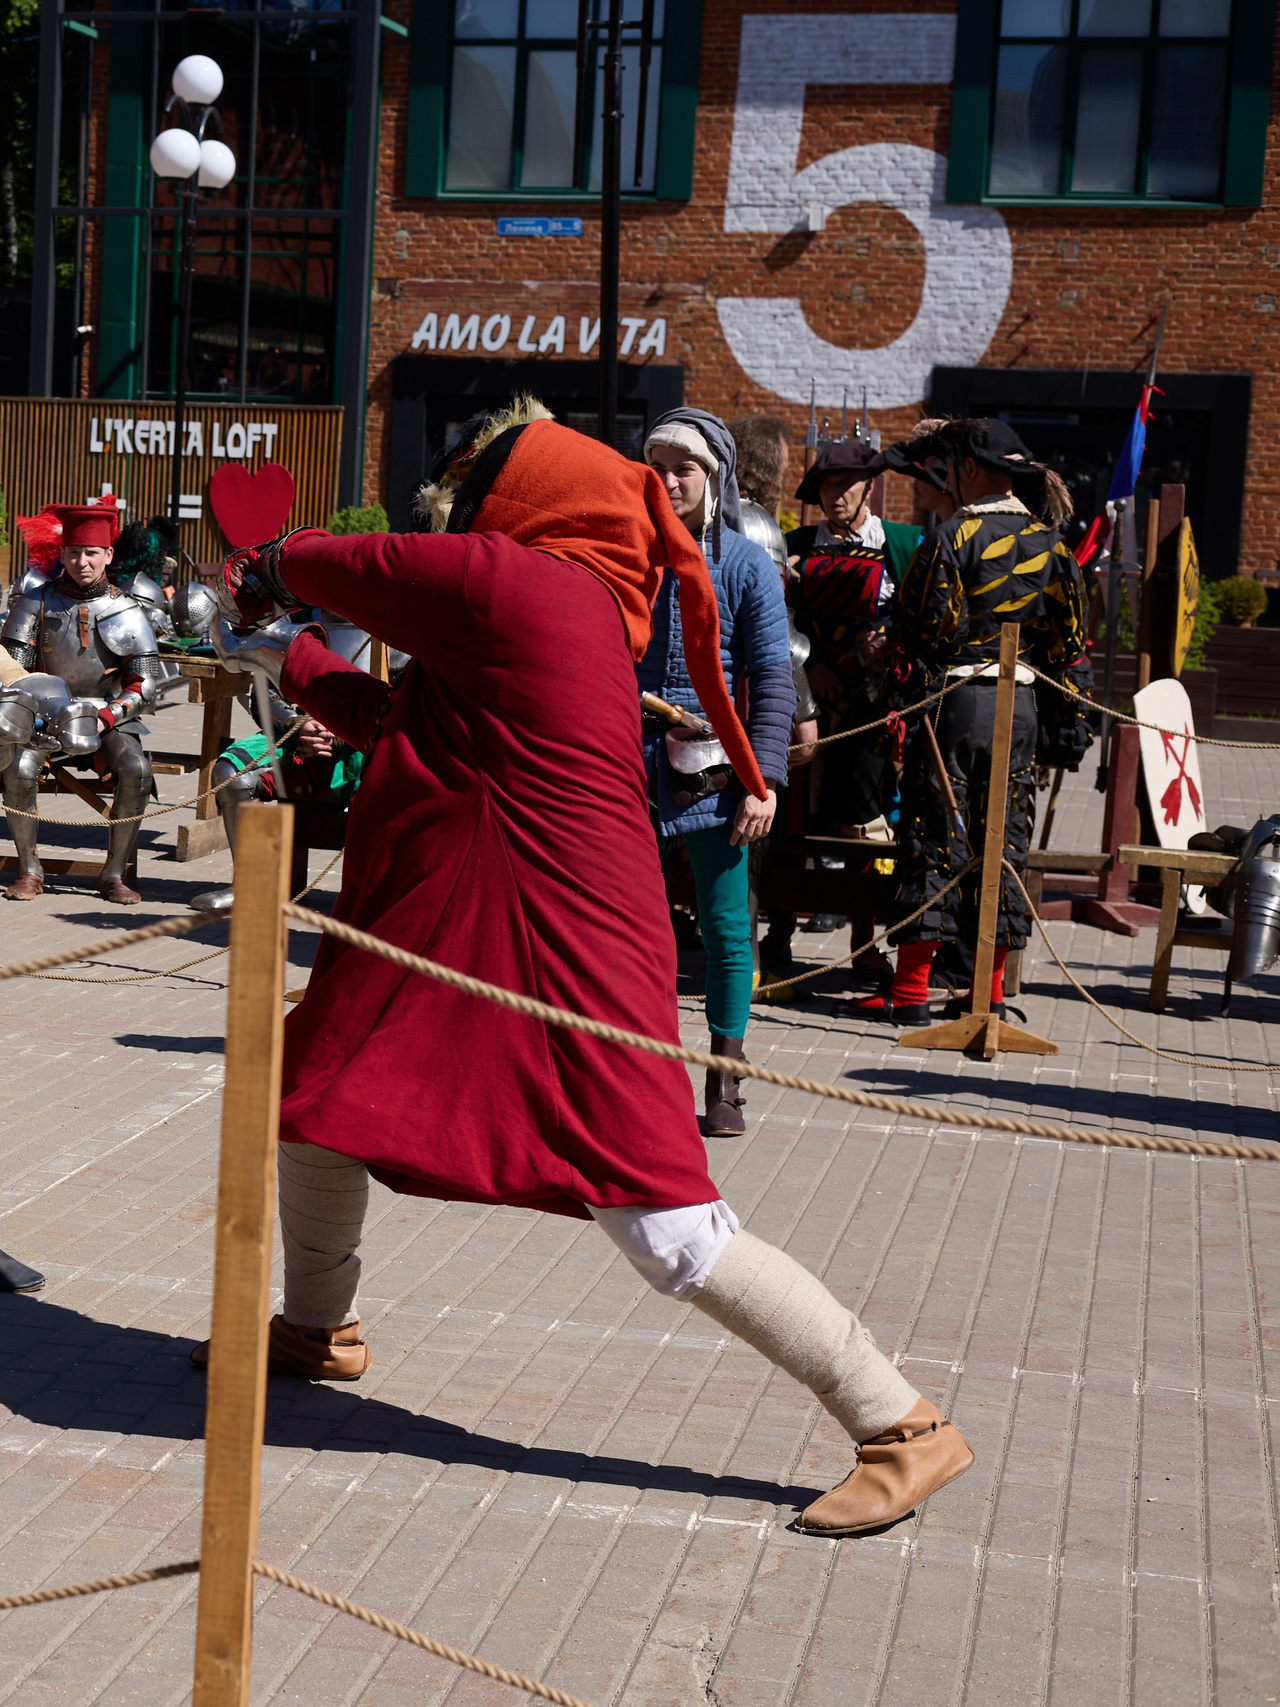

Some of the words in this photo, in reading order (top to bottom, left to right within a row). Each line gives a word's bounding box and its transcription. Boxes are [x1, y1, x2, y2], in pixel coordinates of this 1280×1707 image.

[718, 13, 1013, 410] 5
[411, 313, 512, 351] AMO
[518, 315, 566, 353] LA
[579, 316, 667, 356] VTA
[212, 422, 278, 459] LOFT
